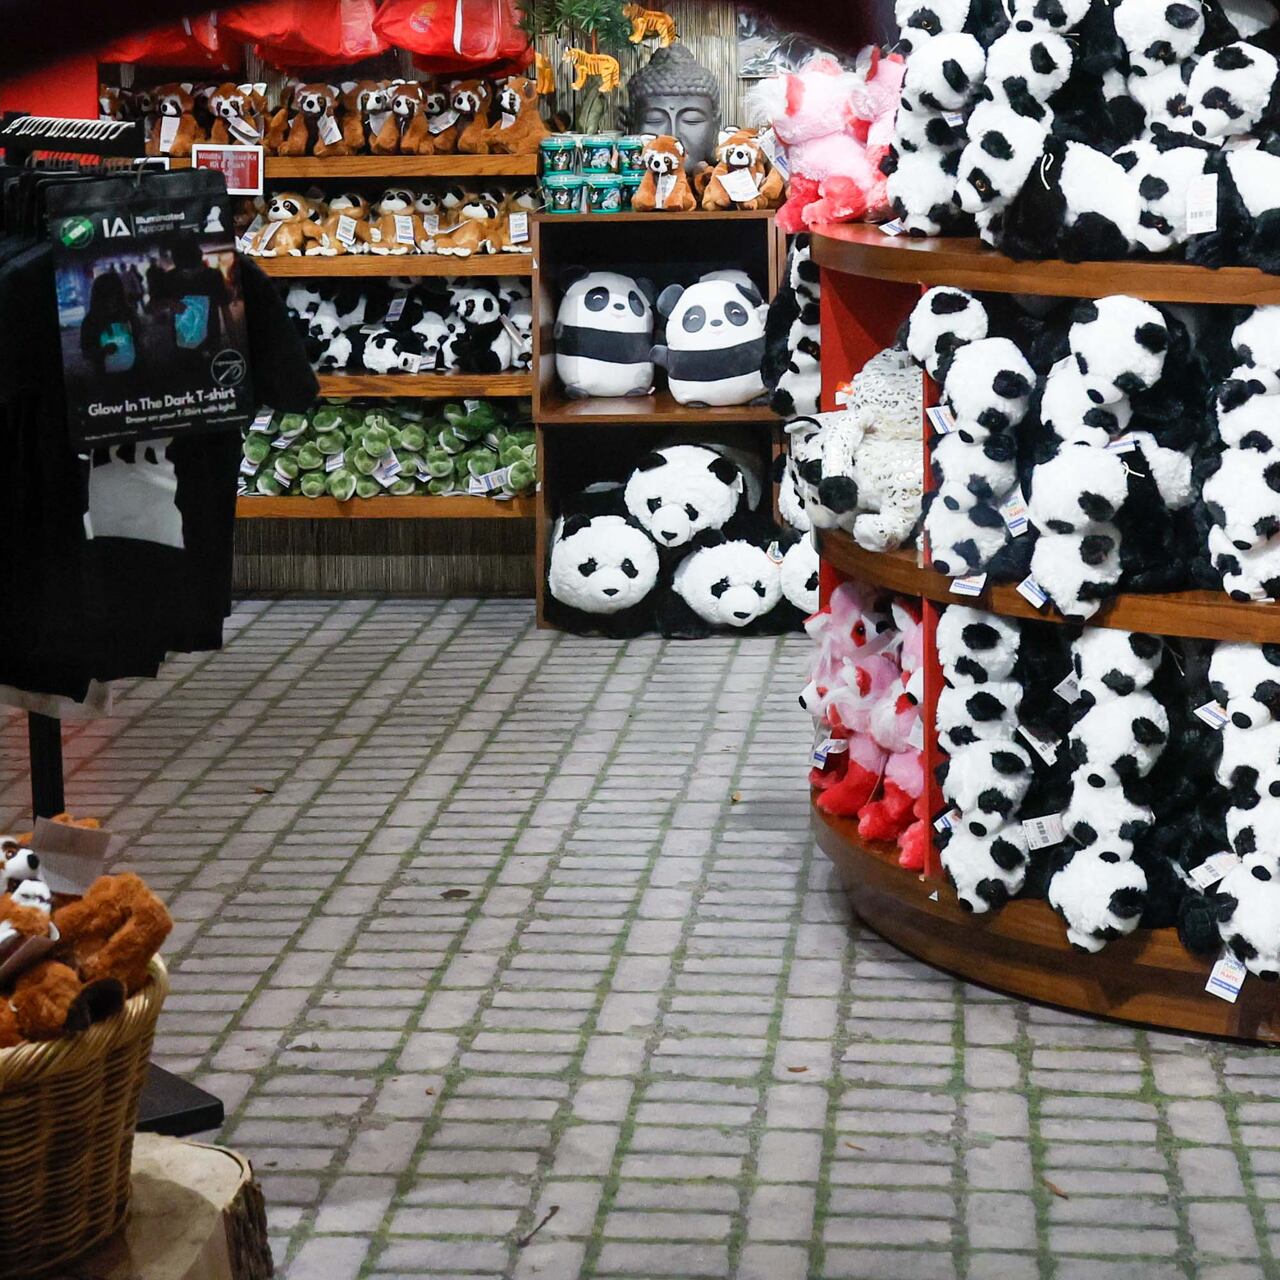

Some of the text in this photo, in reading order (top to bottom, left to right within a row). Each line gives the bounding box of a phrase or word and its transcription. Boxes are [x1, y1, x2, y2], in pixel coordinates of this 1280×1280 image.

[102, 217, 131, 239] IA
[87, 386, 237, 417] Glow In The Dark T-shirt
